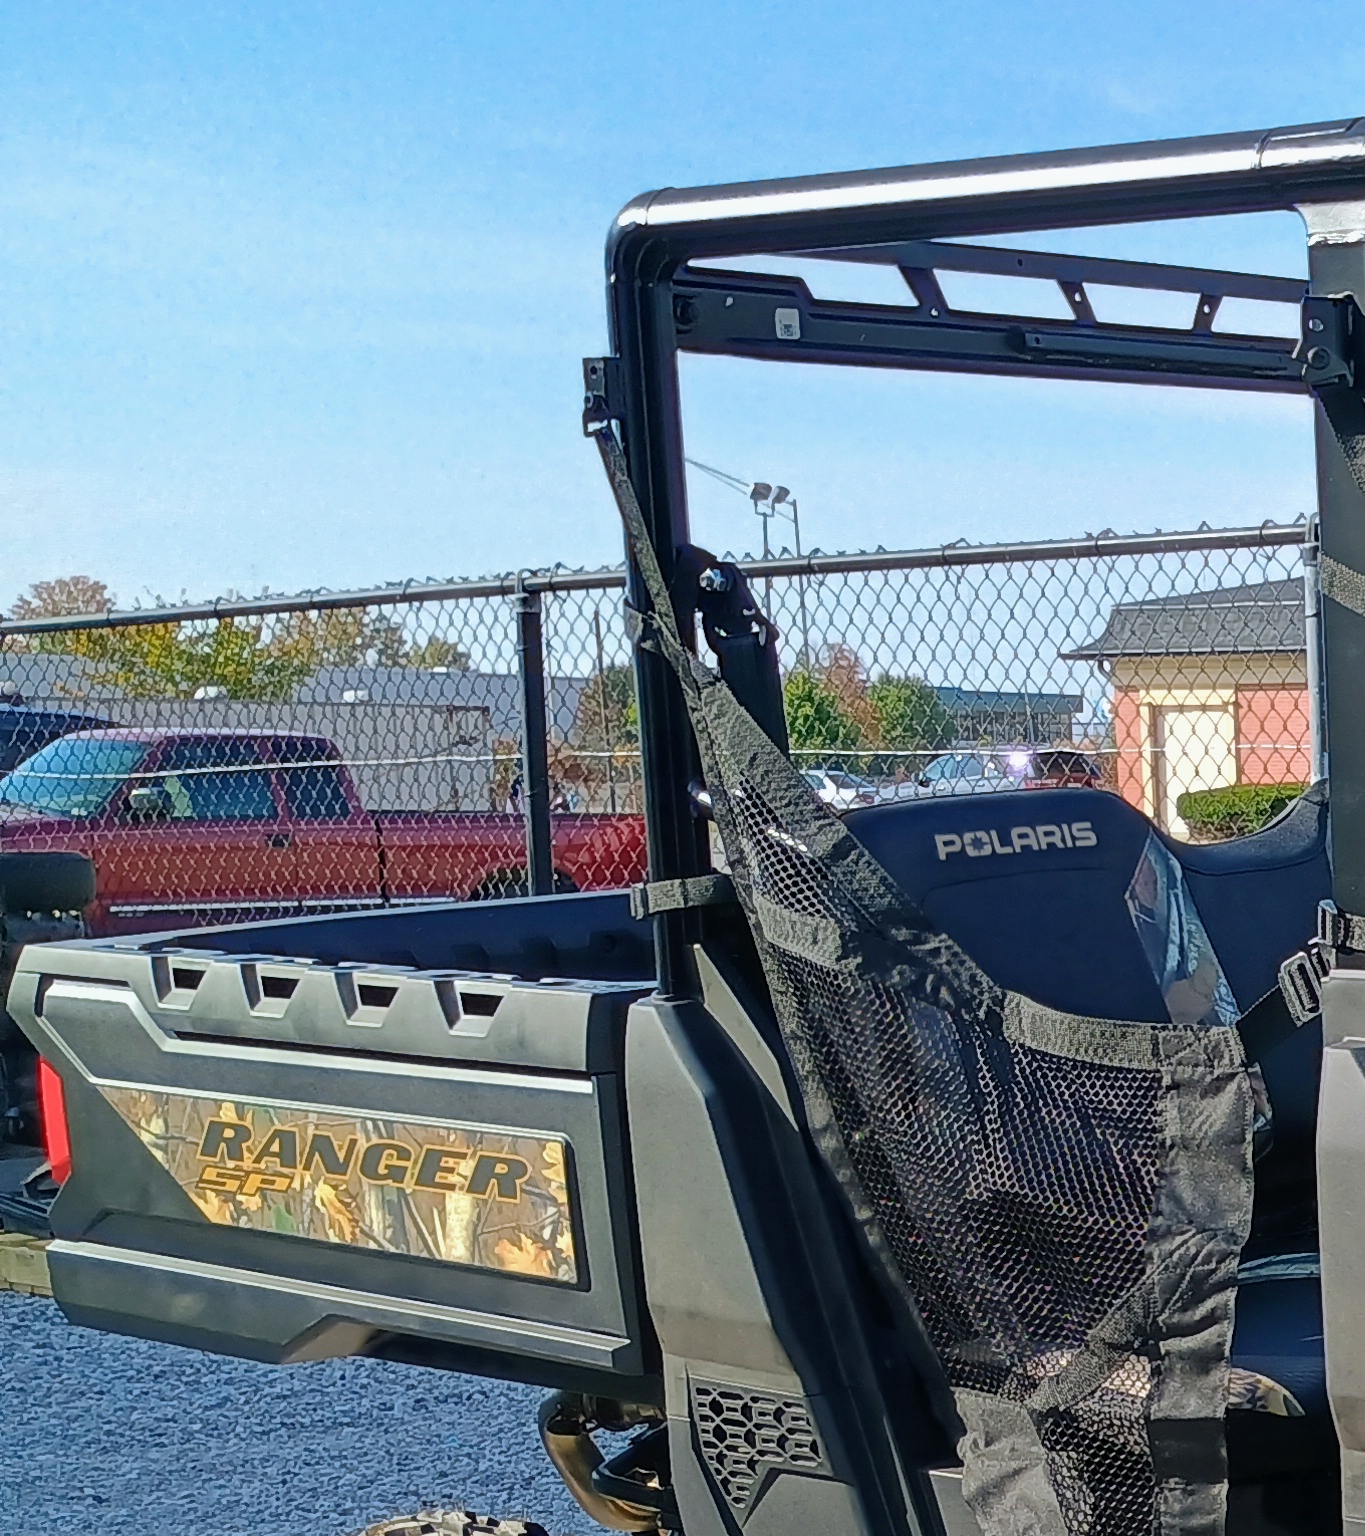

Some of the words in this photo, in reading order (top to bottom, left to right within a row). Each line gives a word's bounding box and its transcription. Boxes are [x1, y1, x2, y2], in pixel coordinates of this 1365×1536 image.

[934, 821, 1098, 861] POLARIS
[197, 1117, 532, 1203] RANGER
[196, 1165, 296, 1197] SP
